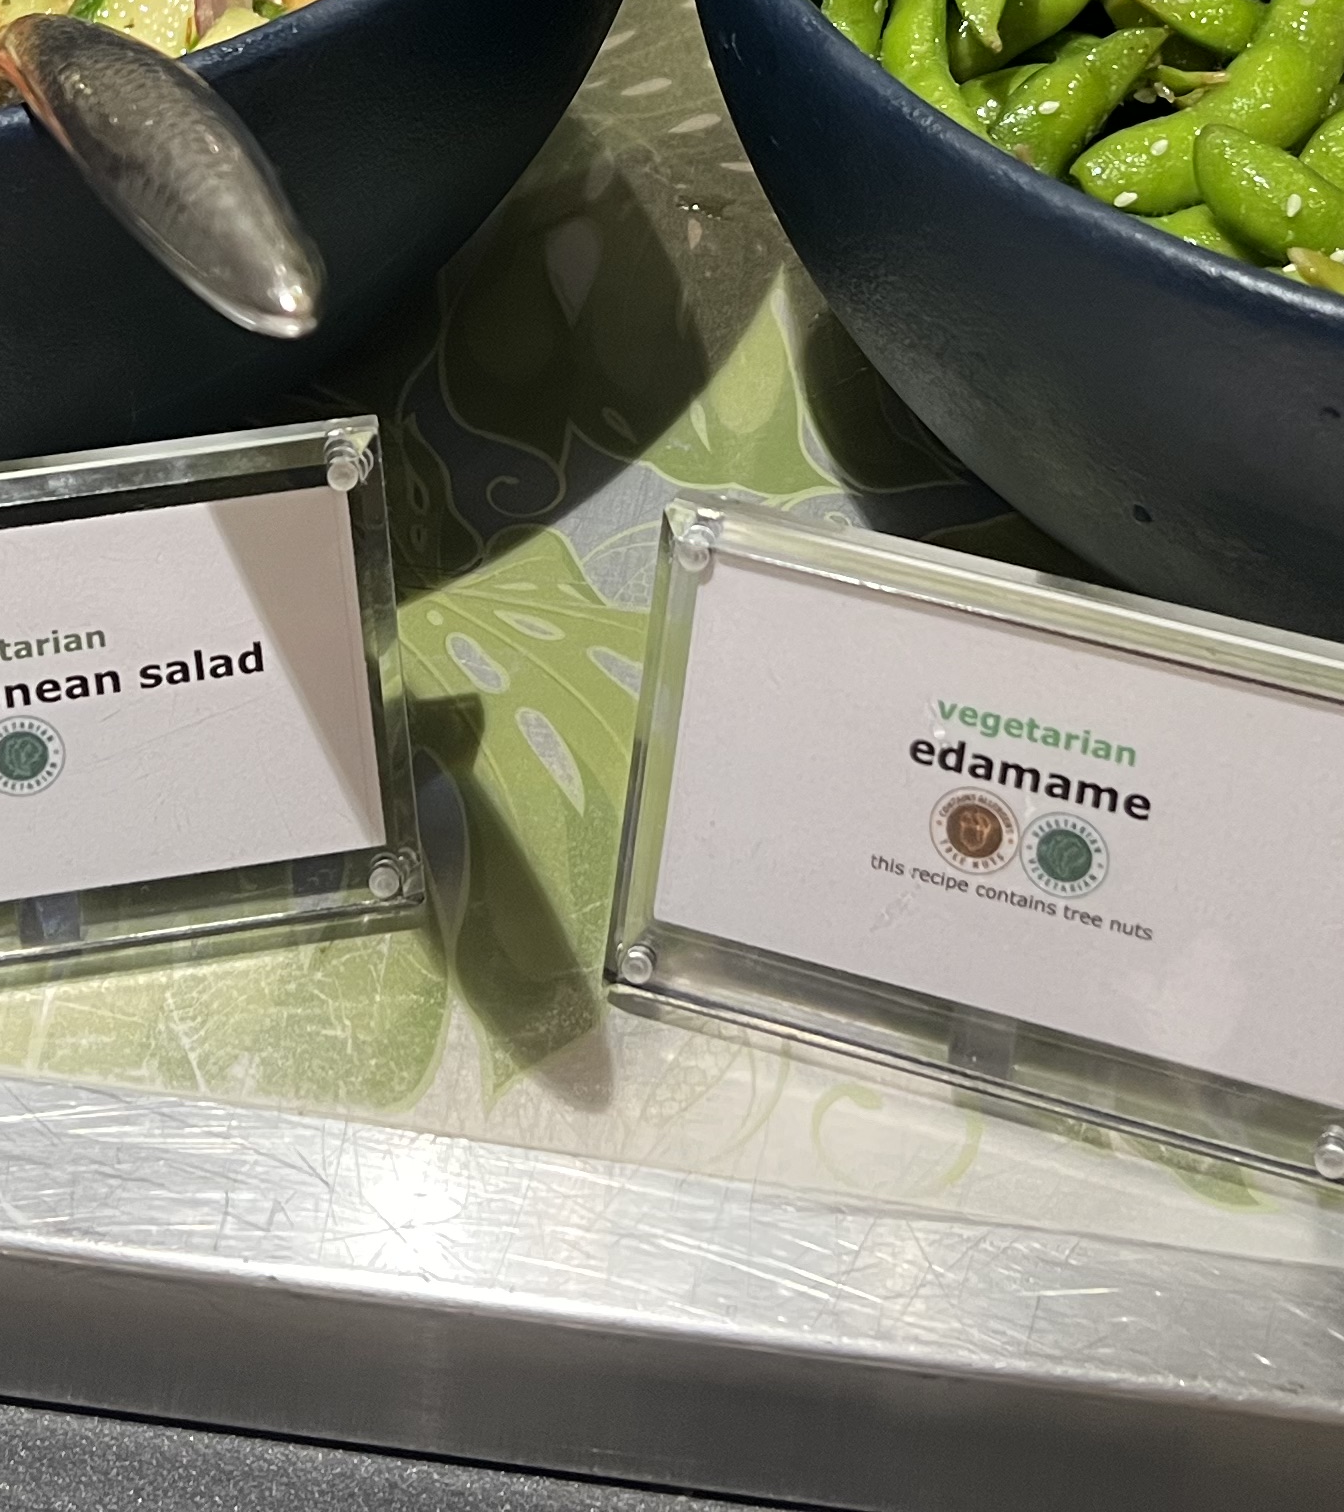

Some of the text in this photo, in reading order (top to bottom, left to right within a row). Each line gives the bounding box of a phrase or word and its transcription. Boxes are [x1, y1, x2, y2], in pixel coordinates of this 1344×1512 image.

[139, 640, 266, 690] salad
[937, 699, 1138, 768] vegetarian
[909, 738, 1152, 821] edamame
[870, 854, 1154, 941] this recipe contains tree nuts
